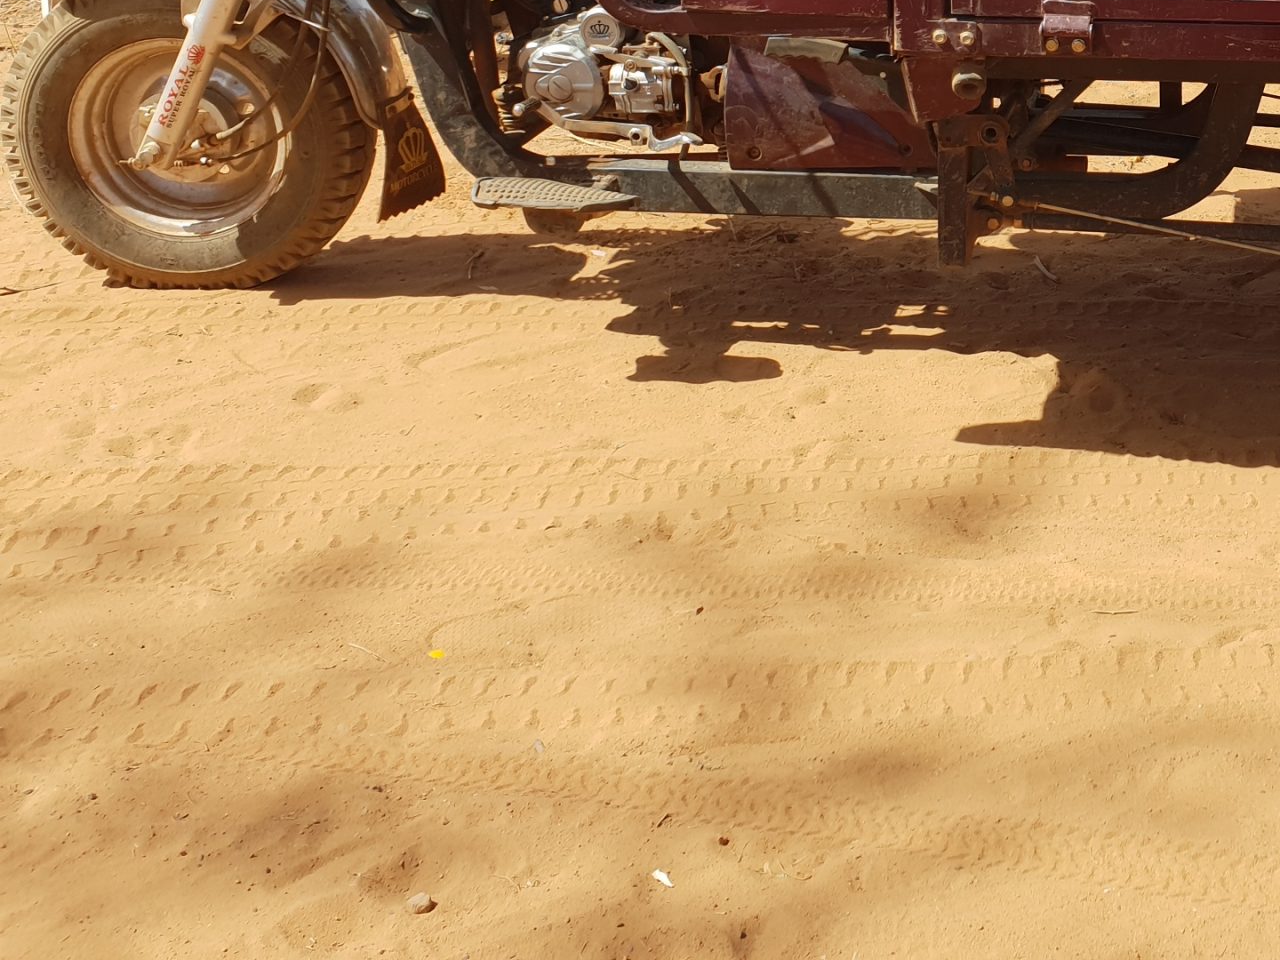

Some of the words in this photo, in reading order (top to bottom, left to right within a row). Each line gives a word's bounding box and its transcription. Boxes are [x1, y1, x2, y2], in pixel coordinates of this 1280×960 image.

[158, 65, 189, 127] ROYAL
[166, 100, 183, 129] SUPER
[180, 68, 196, 98] ROYAL
